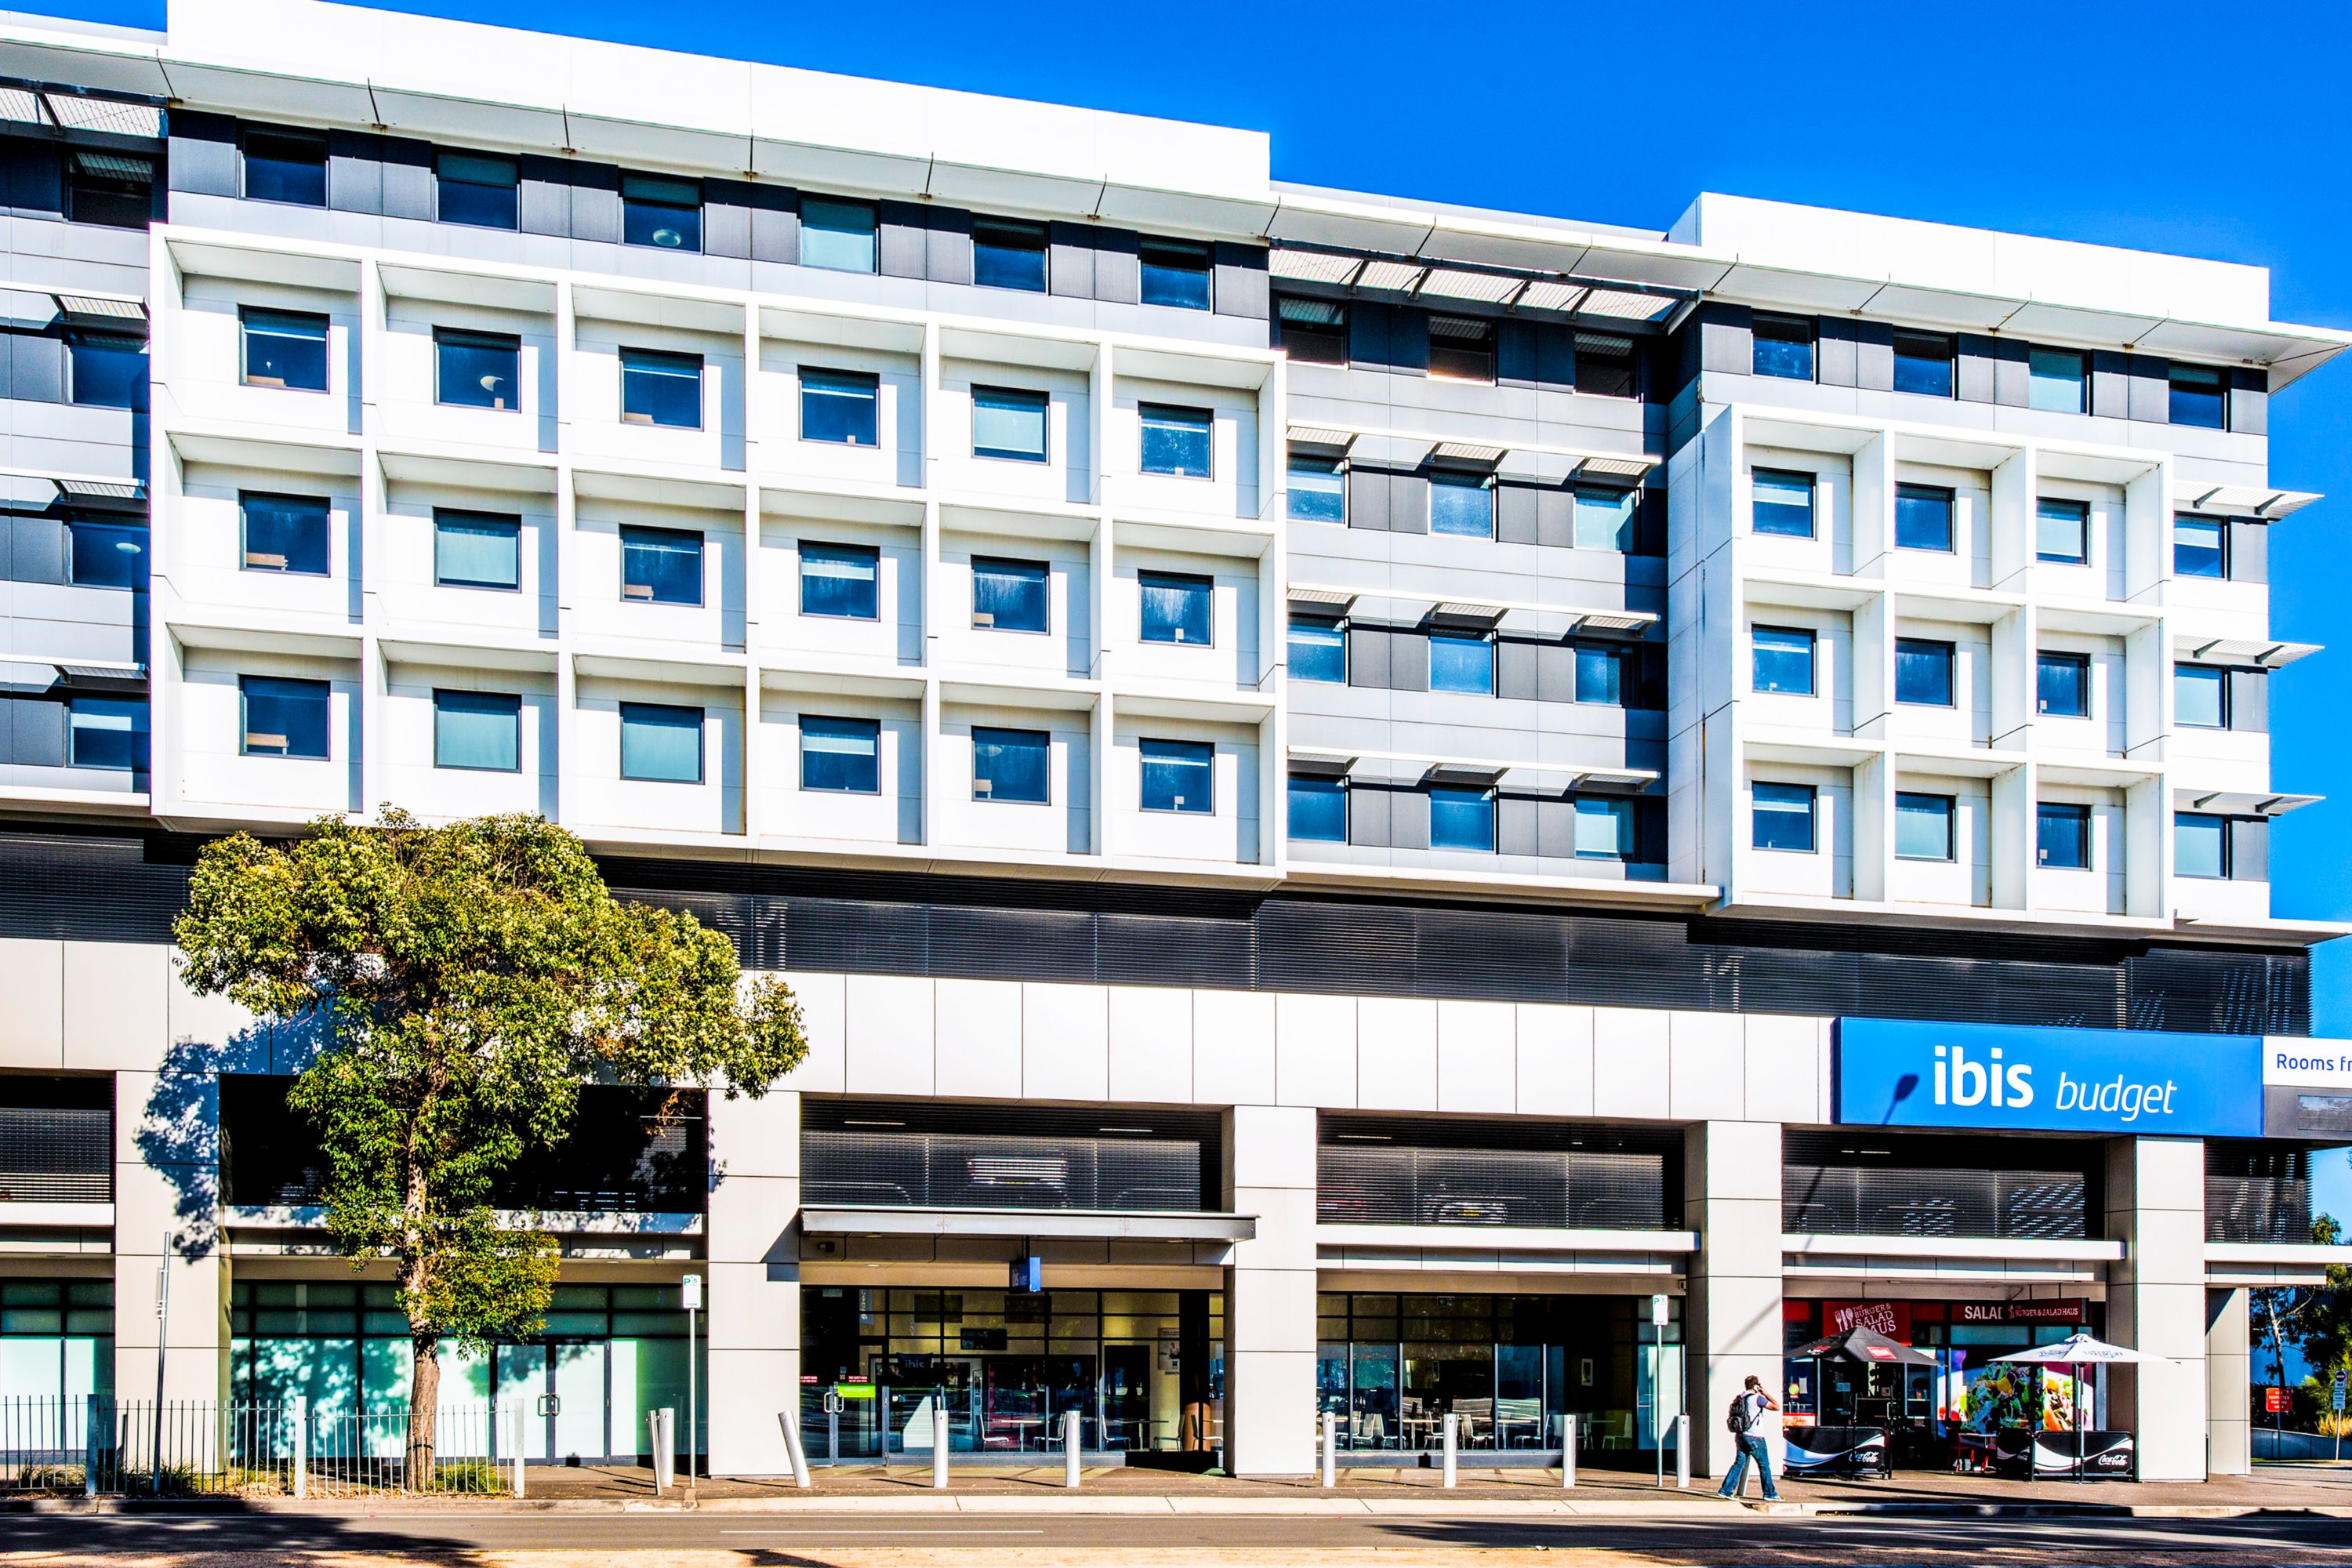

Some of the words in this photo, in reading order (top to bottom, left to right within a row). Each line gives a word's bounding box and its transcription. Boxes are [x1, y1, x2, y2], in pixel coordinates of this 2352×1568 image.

[2277, 1053, 2335, 1072] Rooms
[1934, 1045, 2034, 1108] ibis
[2055, 1071, 2178, 1122] budget
[1854, 1304, 1886, 1319] BURGER
[1855, 1310, 1893, 1327] SALAD
[2062, 1307, 2078, 1316] HAUS
[1871, 1319, 1896, 1334] AUS
